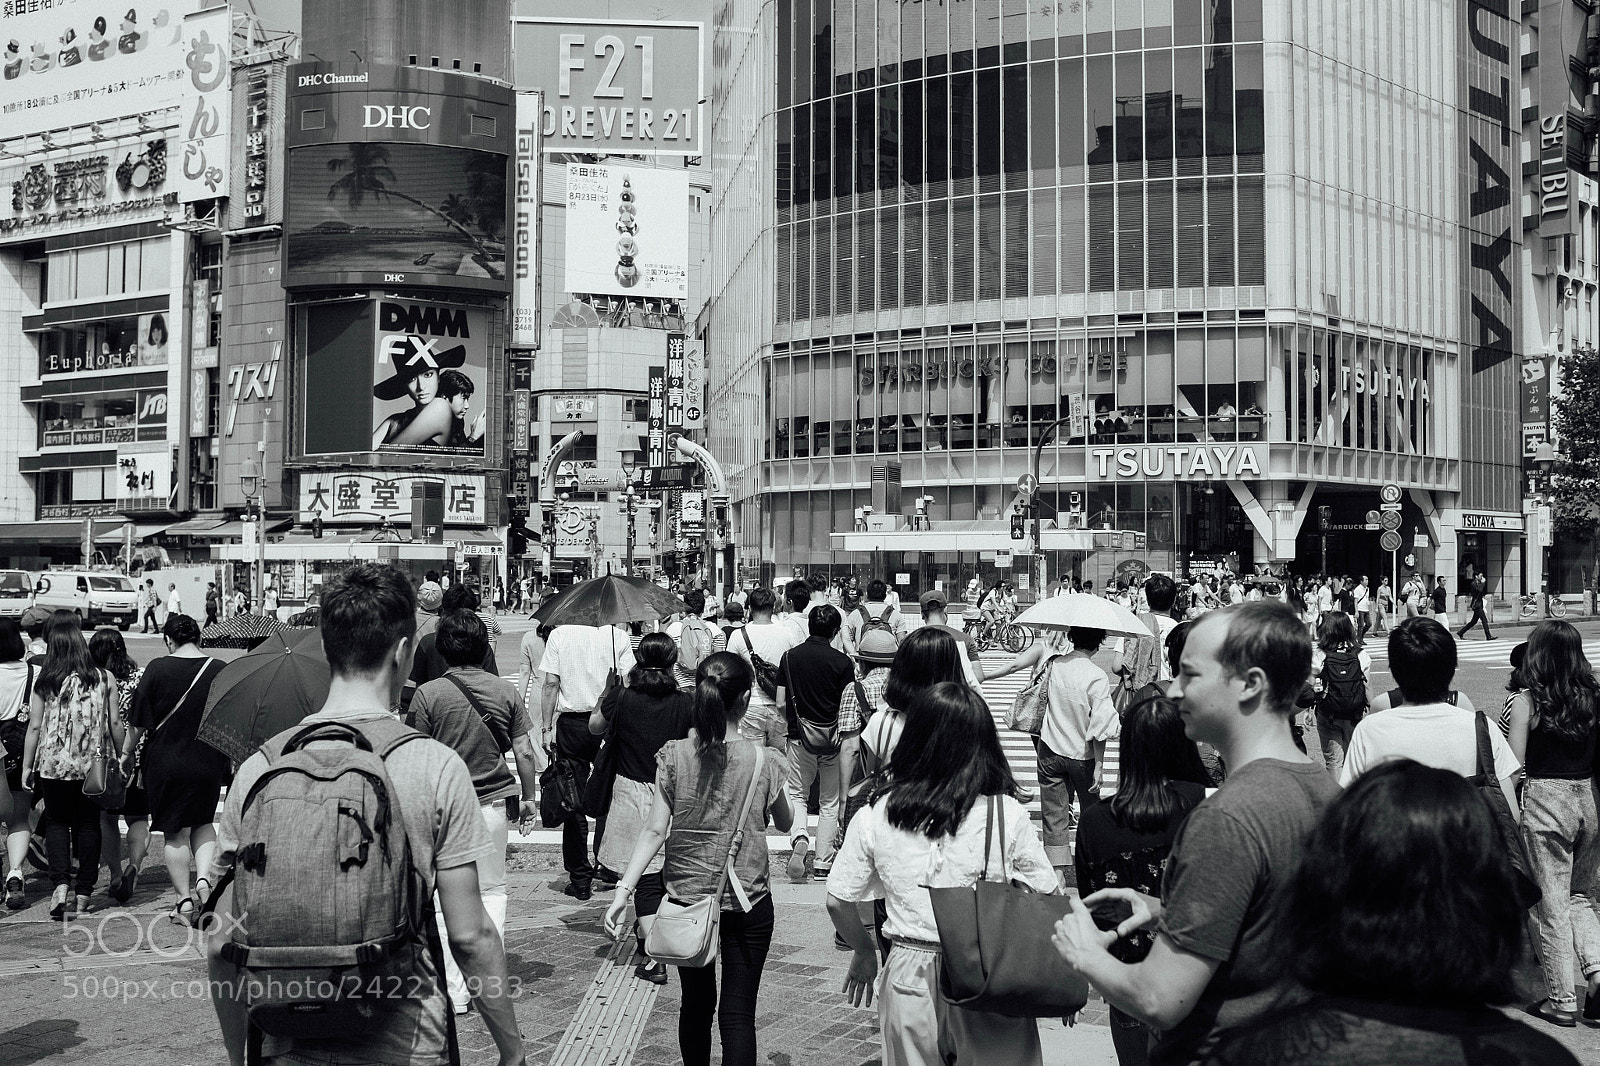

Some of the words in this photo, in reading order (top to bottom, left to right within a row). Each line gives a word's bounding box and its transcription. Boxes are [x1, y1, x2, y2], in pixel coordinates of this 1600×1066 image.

[298, 75, 322, 87] DHC
[323, 72, 369, 84] Channel
[559, 34, 654, 99] F21
[183, 30, 227, 193] もんじゃ
[362, 105, 431, 130] DHC
[544, 105, 654, 139] OREVER
[663, 108, 692, 140] 21
[569, 166, 608, 178] 桑田佳祐
[1541, 114, 1568, 217] SEIBU
[516, 212, 530, 280] neon
[384, 273, 405, 283] DHC
[379, 301, 470, 339] DMM
[515, 307, 532, 316] (03)
[515, 316, 532, 324] 3719
[515, 324, 532, 332] 2468
[50, 350, 132, 371] Euphoria
[378, 334, 439, 369] FX
[667, 338, 683, 426] 洋服の青山
[139, 393, 167, 420] JTB
[687, 410, 699, 419] 4F
[649, 377, 663, 467] 洋服の青山
[1093, 447, 1261, 477] TSUTAYA
[308, 481, 476, 514] 大盛堂店
[1463, 514, 1495, 527] TSUTAYA
